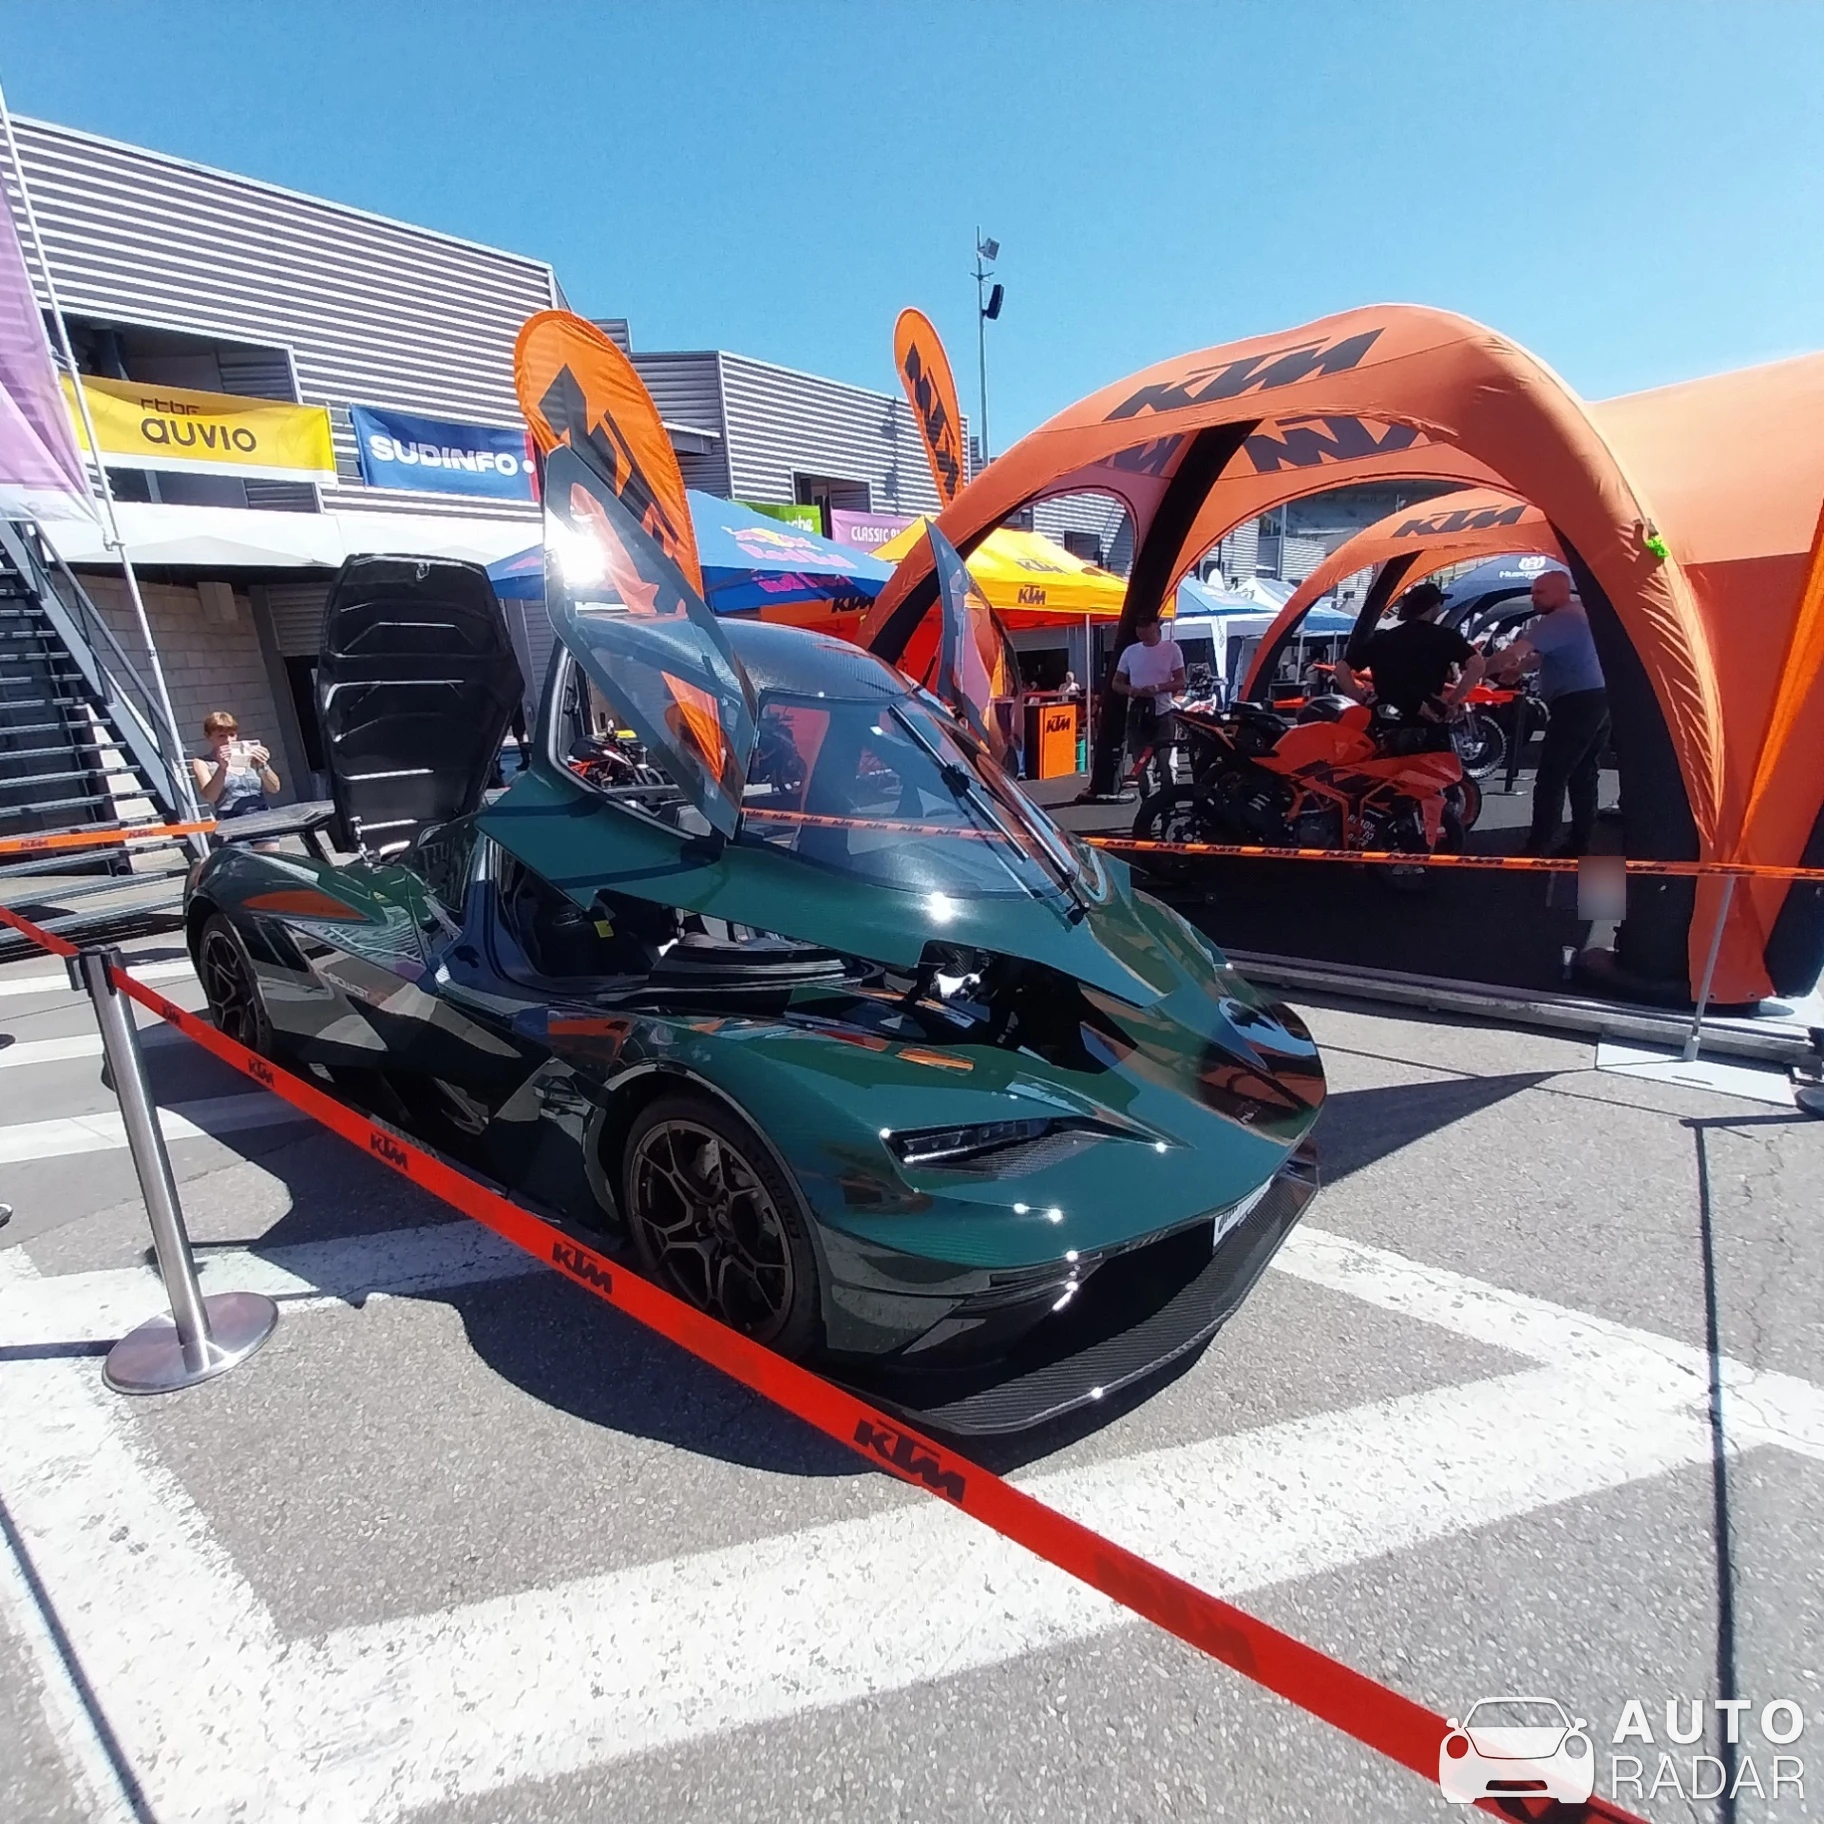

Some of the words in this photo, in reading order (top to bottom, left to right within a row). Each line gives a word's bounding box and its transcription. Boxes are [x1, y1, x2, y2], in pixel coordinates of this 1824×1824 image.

[1101, 327, 1386, 422] KTM
[141, 418, 257, 452] auvio
[369, 435, 519, 477] SUDINFO
[851, 526, 889, 543] CLASSIC
[1391, 504, 1528, 538] KTM
[1018, 584, 1046, 605] KTM
[1046, 714, 1071, 733] KTM
[248, 1056, 275, 1088] KTM
[369, 1131, 409, 1172] KTM
[553, 1240, 614, 1295] KTM
[853, 1418, 967, 1503] KTM
